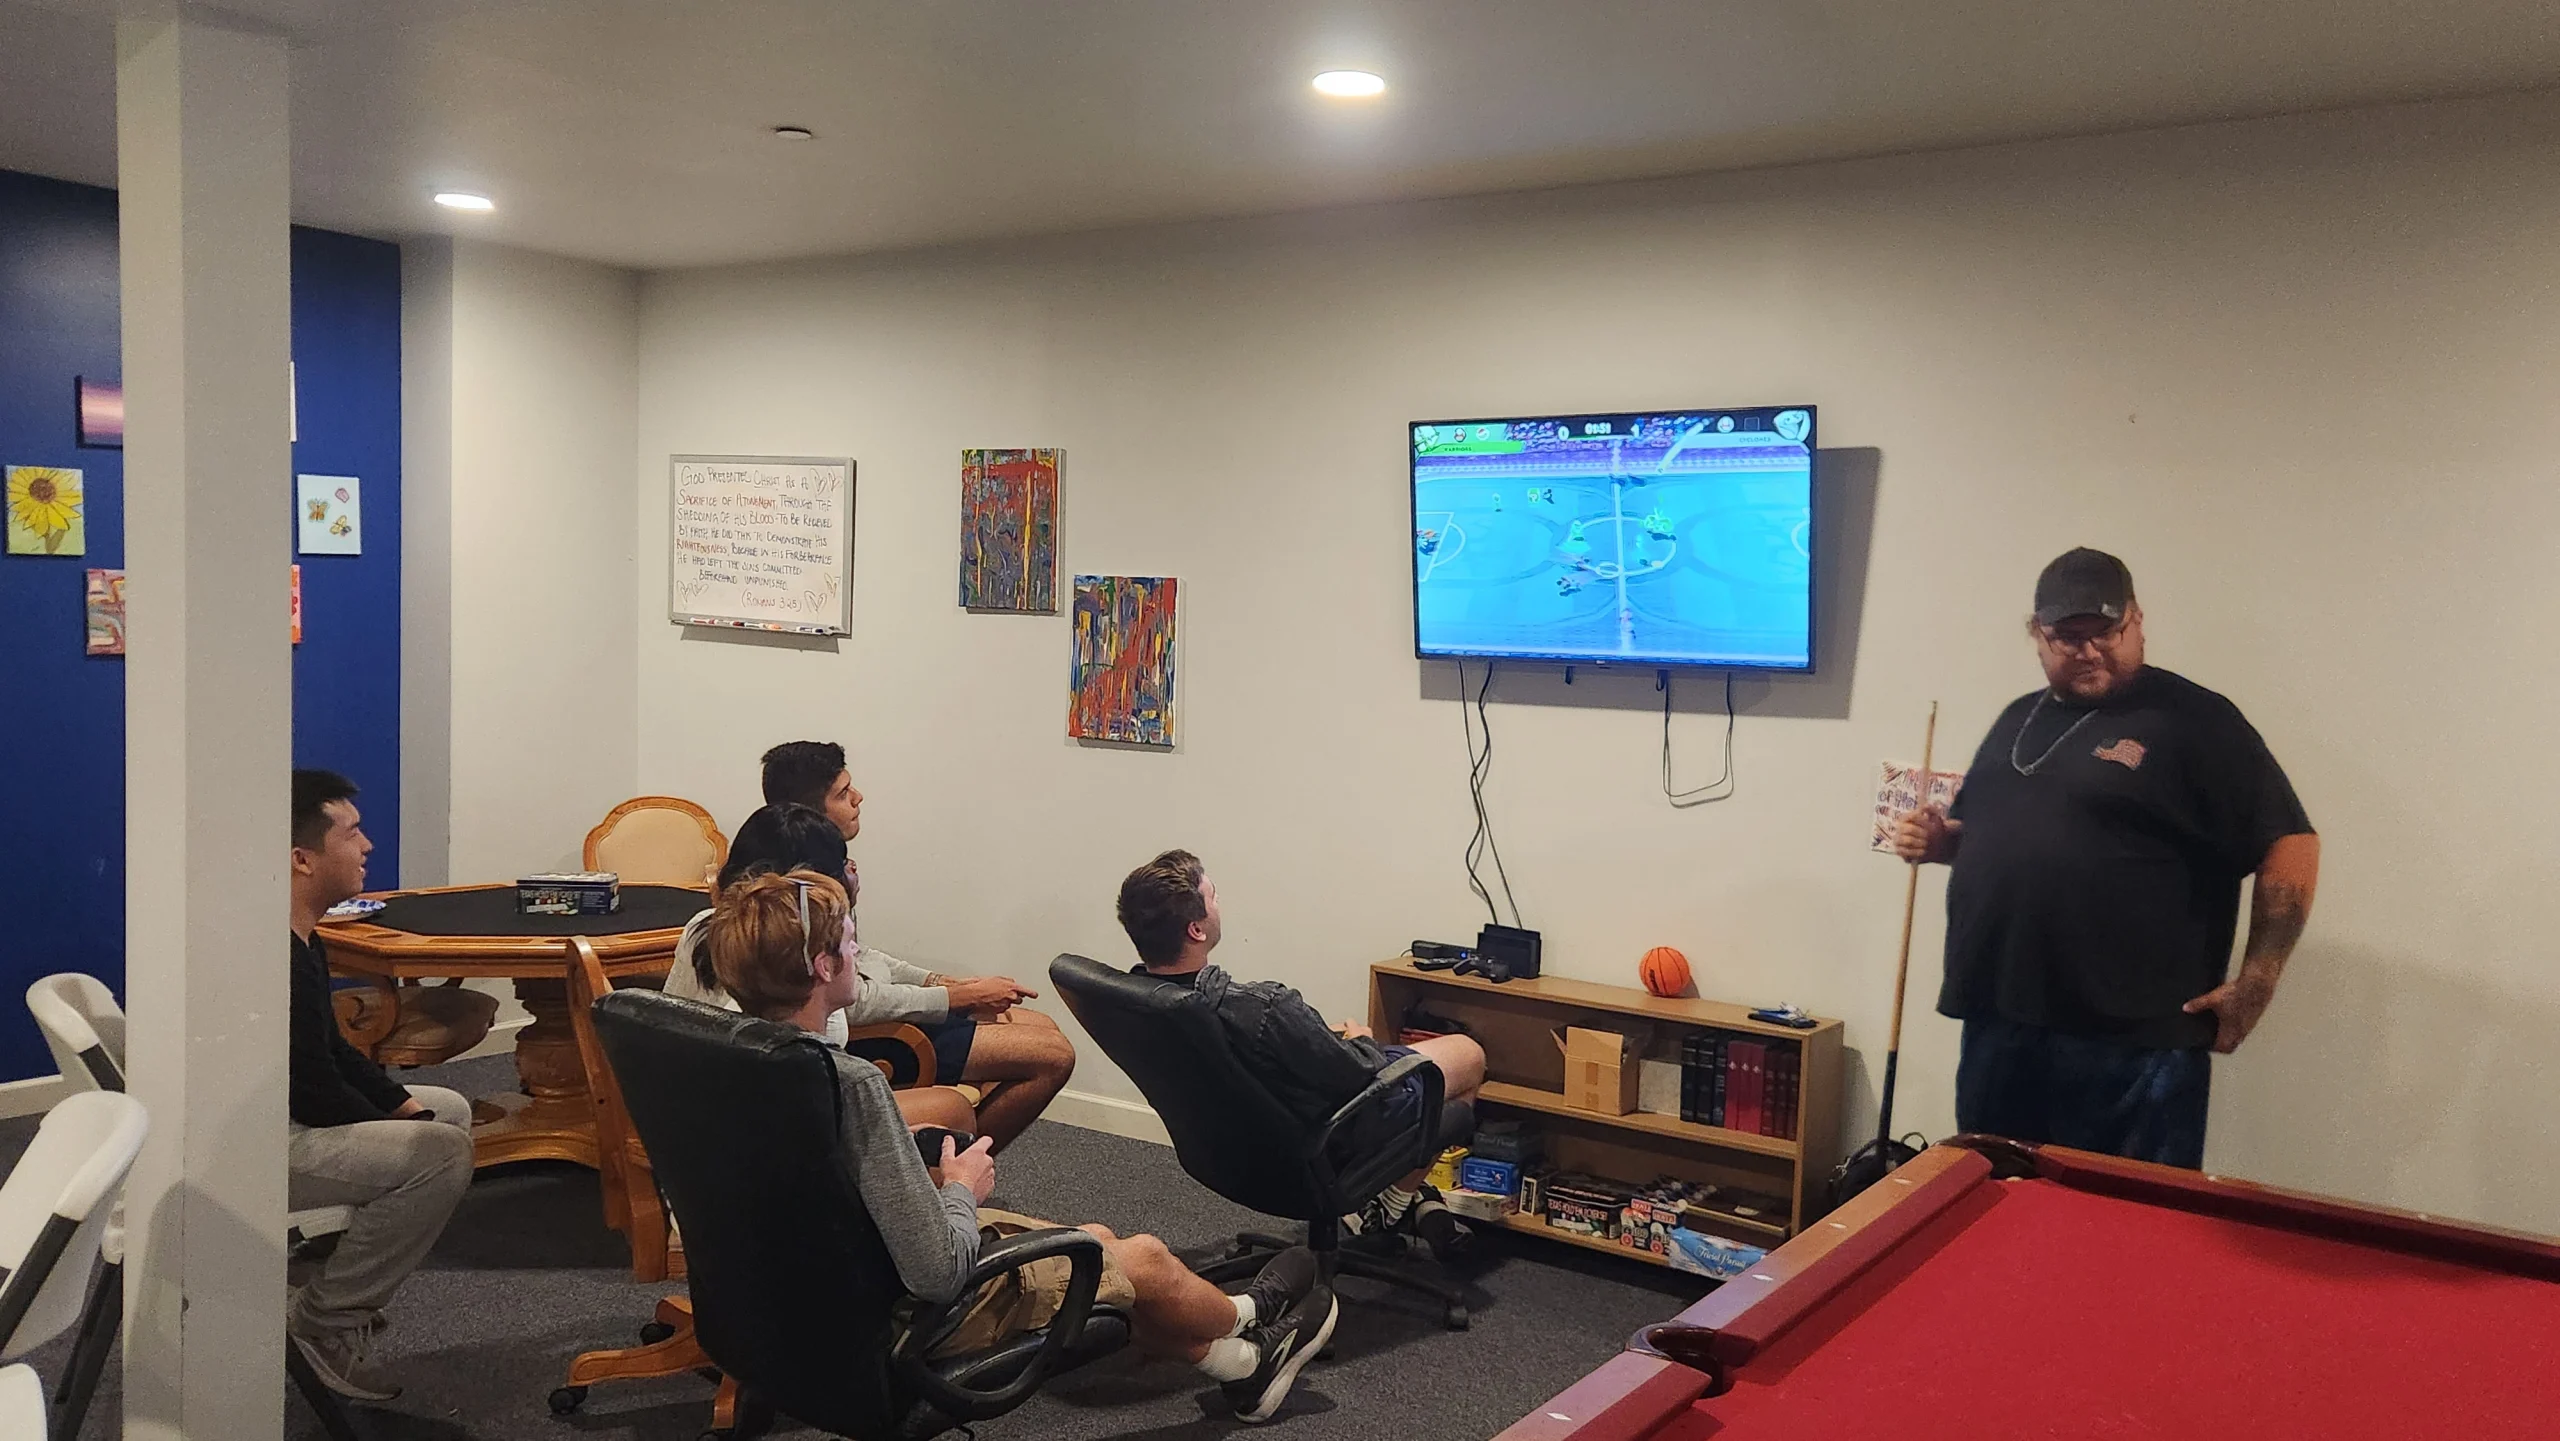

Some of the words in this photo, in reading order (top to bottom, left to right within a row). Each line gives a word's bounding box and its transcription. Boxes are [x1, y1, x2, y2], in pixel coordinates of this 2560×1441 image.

[721, 496, 733, 506] OF
[720, 511, 730, 524] OF
[707, 557, 723, 569] LEFT
